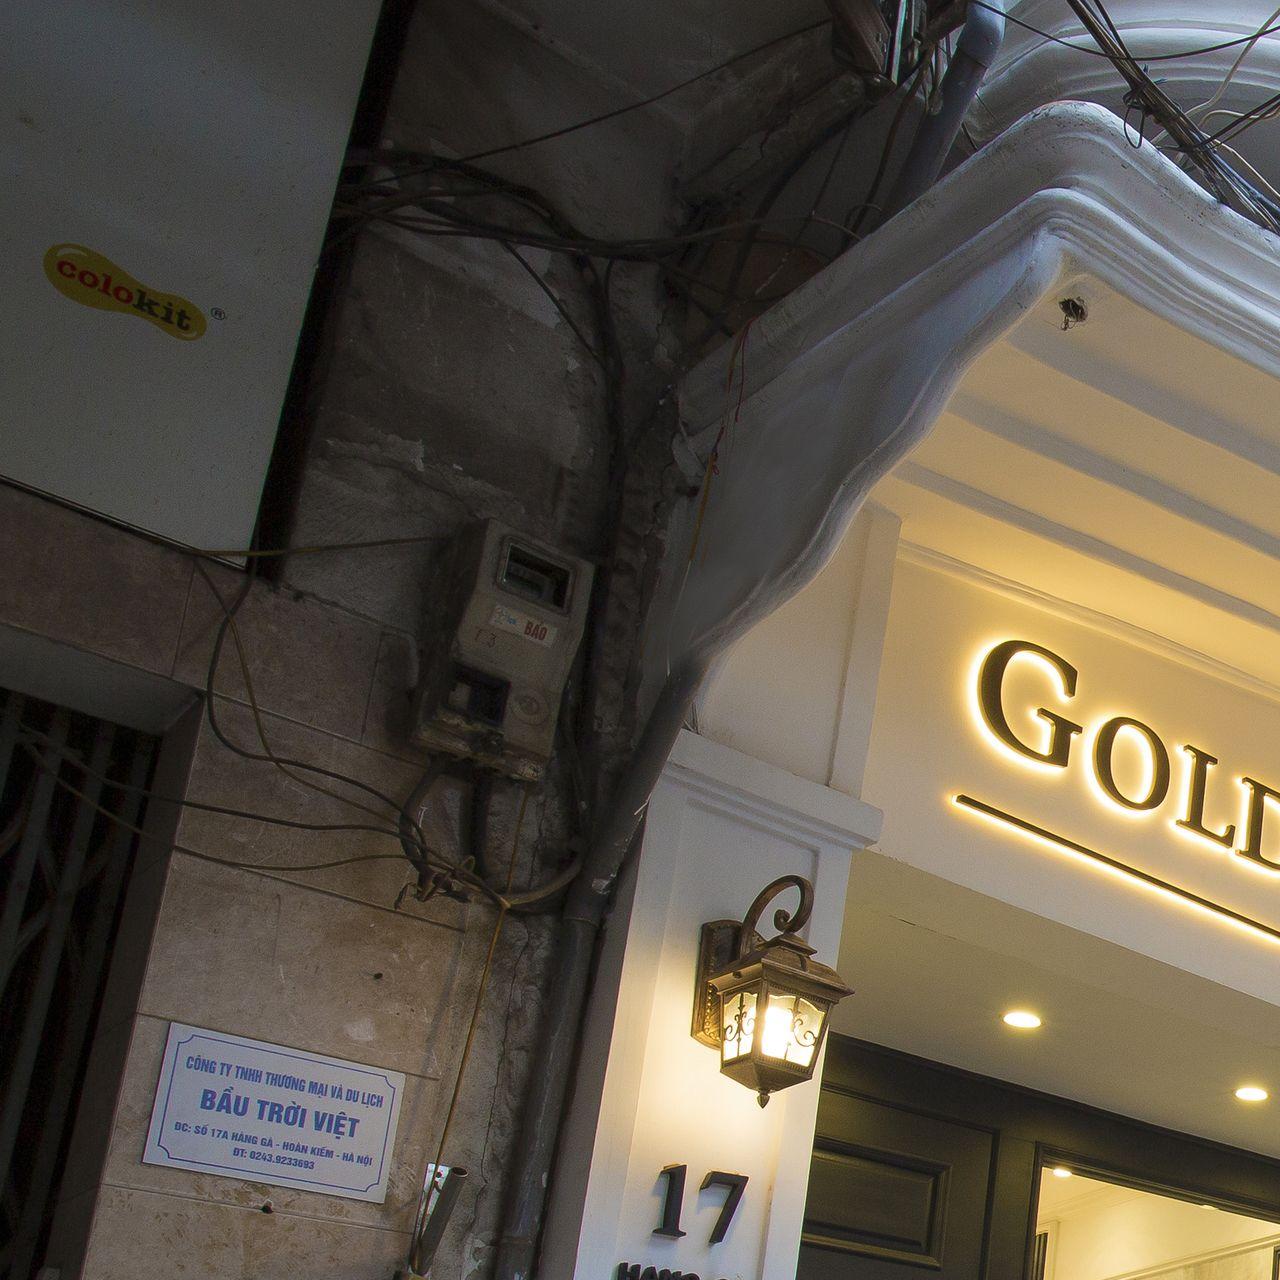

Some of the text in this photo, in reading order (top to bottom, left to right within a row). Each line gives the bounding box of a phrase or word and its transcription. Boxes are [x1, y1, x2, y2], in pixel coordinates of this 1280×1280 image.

[57, 259, 191, 332] colokit
[186, 1055, 384, 1109] CÔNG TY TNHH THƯƠNG MẠI VÀ DU LỊCH
[193, 1123, 209, 1136] SỐ
[211, 1128, 229, 1140] 17A
[231, 1131, 259, 1145] HÀNG
[260, 1136, 273, 1148] GÀ
[282, 1141, 309, 1155] HOÀN
[310, 1146, 334, 1159] KIẾM
[356, 1155, 373, 1168] NỘI
[257, 1099, 307, 1129] TRỜI
[314, 1110, 360, 1140] VIỆT
[652, 1155, 750, 1247] 17
